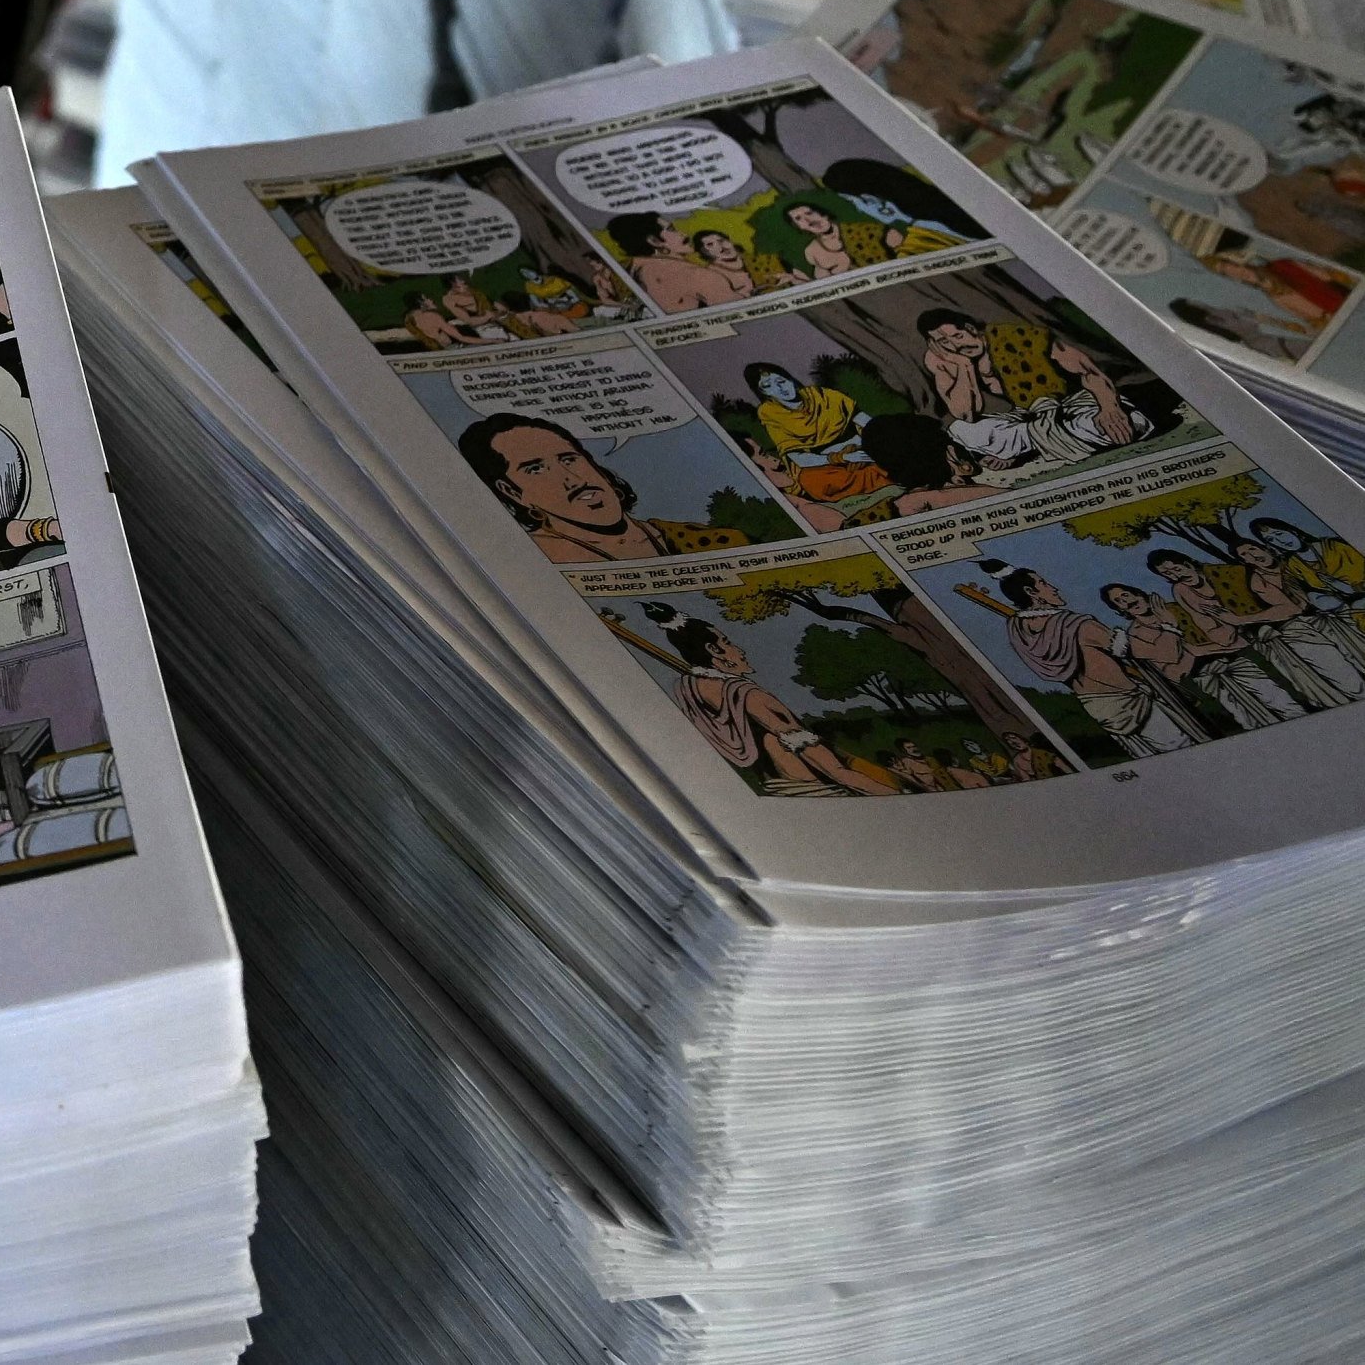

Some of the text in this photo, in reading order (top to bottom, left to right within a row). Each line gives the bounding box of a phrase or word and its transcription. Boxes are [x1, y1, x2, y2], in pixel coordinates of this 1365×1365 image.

[961, 515, 982, 525] HIM
[986, 507, 1017, 520] KING
[1020, 481, 1104, 511] YUDHISHTHIRA
[1108, 476, 1133, 489] AND
[1137, 469, 1159, 481] HIS
[1161, 450, 1226, 474] BROTHERS
[896, 467, 1218, 553] STOOD UP AND DULY WORSHIPPED THE ILLUSTRIOUS
[646, 569, 668, 577] THE
[673, 563, 736, 576] CELESTIAL
[738, 559, 768, 568] RISHI
[773, 550, 819, 563] NARADA
[585, 582, 646, 592] APPEARED
[652, 578, 697, 588] BEFORE
[1112, 770, 1139, 782] 664
